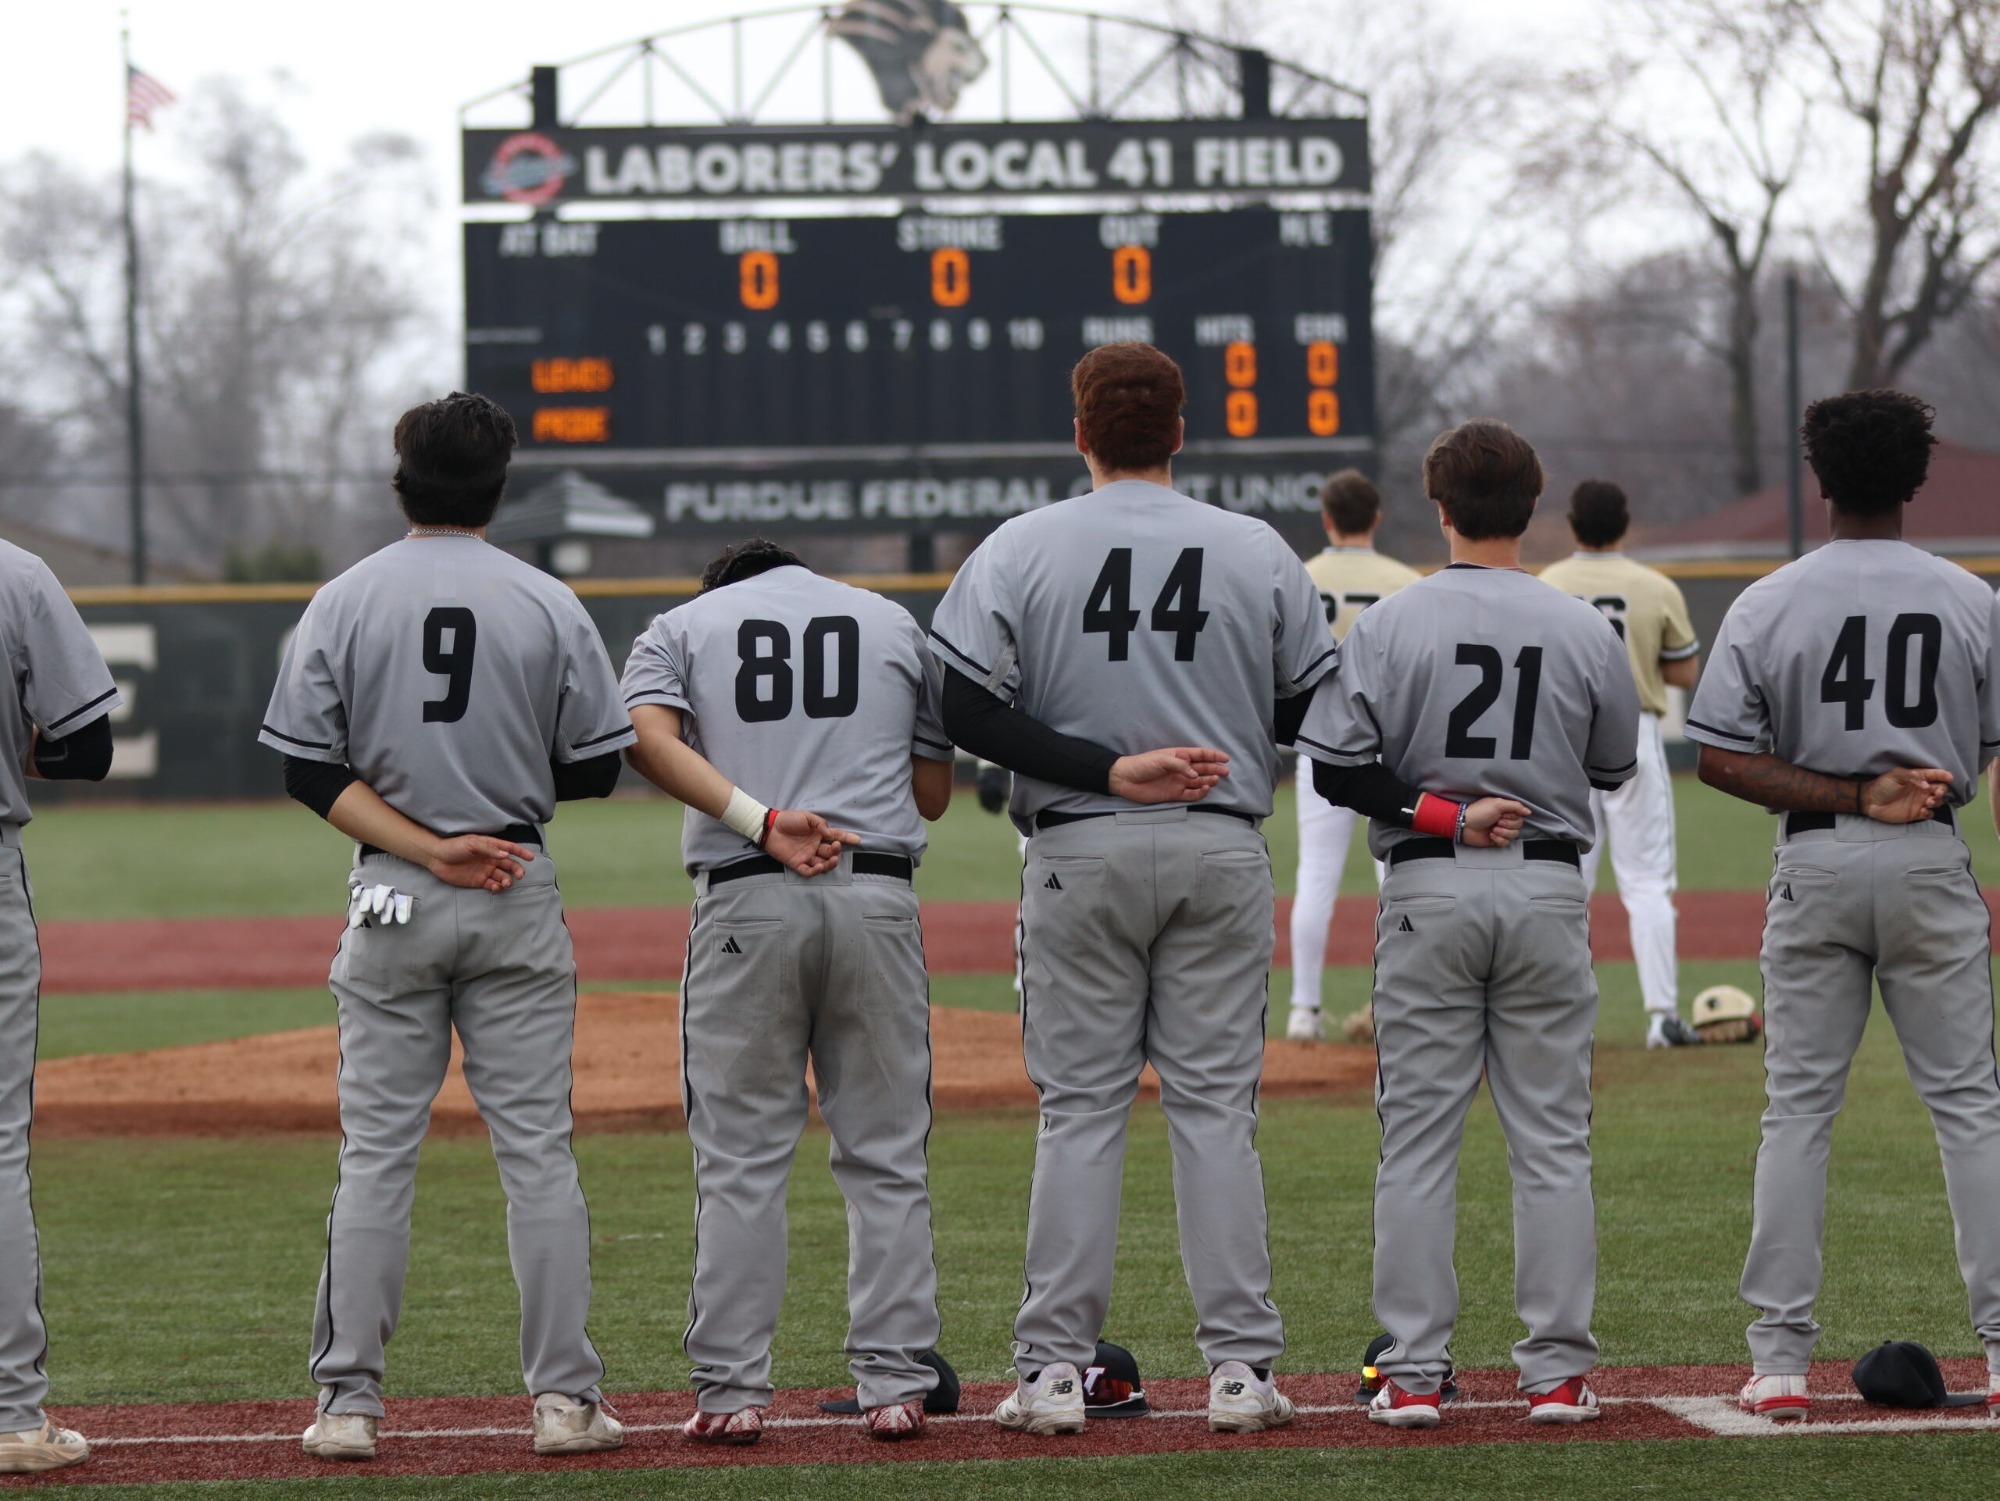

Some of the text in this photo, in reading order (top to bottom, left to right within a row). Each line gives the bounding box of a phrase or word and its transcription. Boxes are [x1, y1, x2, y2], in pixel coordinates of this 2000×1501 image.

[914, 139, 1097, 189] LOCAL
[1107, 138, 1173, 187] 41
[1195, 137, 1343, 186] FIELD
[499, 224, 537, 257] AT
[718, 219, 797, 253] BALL
[897, 216, 1003, 251] STRIKE
[1099, 215, 1161, 248] OUT
[739, 250, 779, 310] 0
[930, 247, 970, 307] 0
[1112, 245, 1152, 304] 0
[647, 323, 668, 355] 1
[683, 322, 708, 355] 2
[723, 320, 748, 354] 3
[768, 320, 792, 353] 4
[806, 319, 831, 353] 5
[844, 319, 870, 352] 6
[891, 319, 914, 351] 7
[967, 318, 991, 351] 9
[1006, 317, 1044, 351] 10
[1225, 339, 1338, 388] 0 0
[1226, 386, 1340, 438] 0 0
[665, 481, 853, 522] PURDUE
[1083, 547, 1210, 662] 44
[423, 607, 476, 723] 9
[735, 615, 859, 722] 80
[1821, 612, 1941, 731] 40
[1445, 643, 1543, 761] 21
